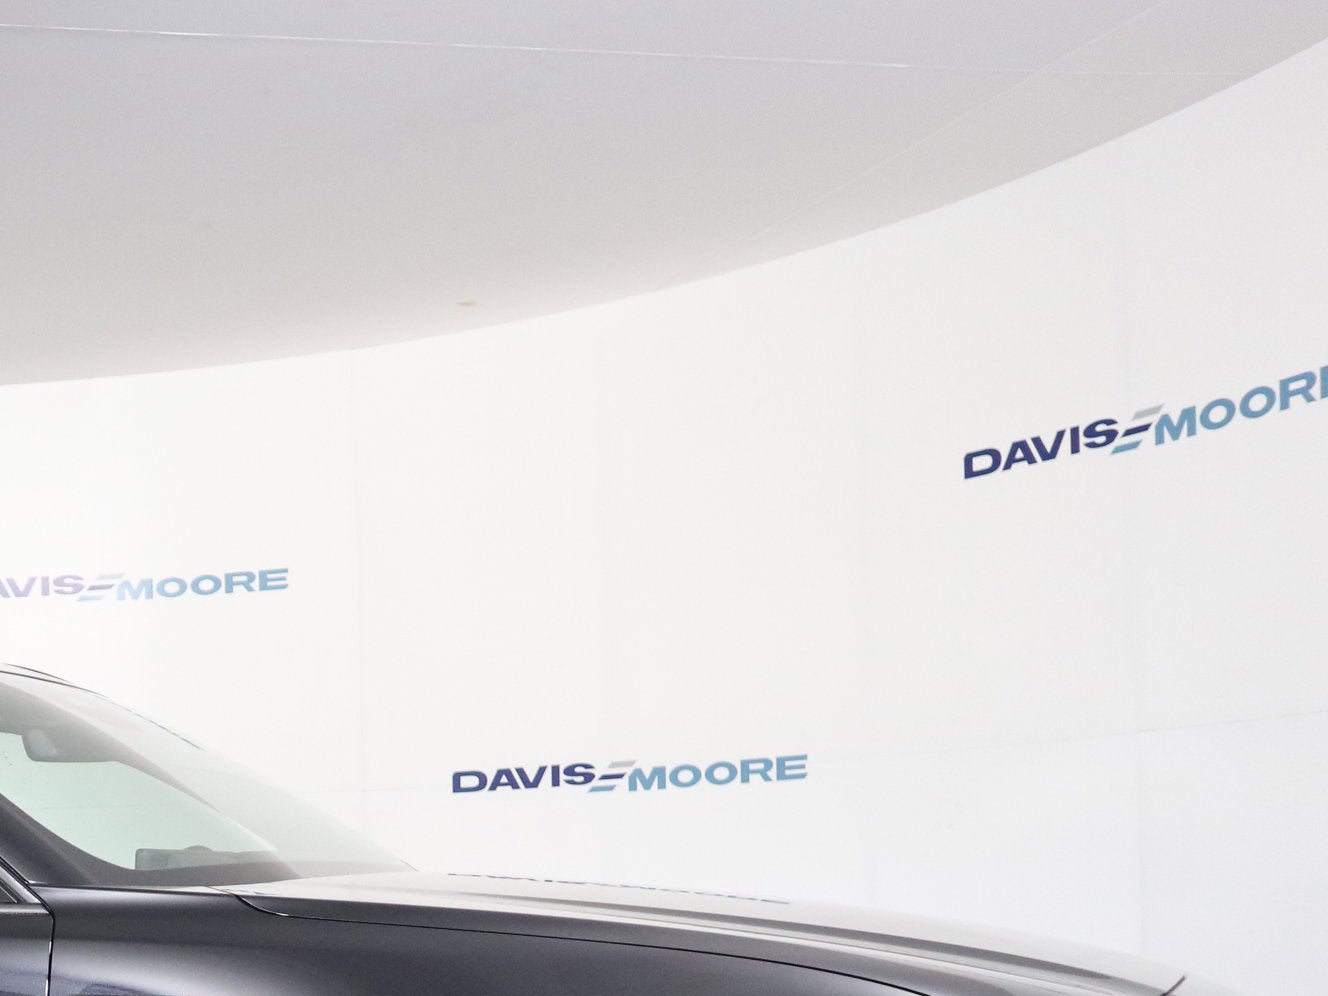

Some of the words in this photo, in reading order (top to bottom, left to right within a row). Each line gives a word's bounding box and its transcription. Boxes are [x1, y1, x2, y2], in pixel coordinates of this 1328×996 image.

[963, 418, 1119, 479] DAVIS
[1153, 365, 1328, 446] MOOR
[116, 567, 289, 601] MOORE
[452, 762, 596, 793] DAVIS
[628, 753, 808, 792] MOORE
